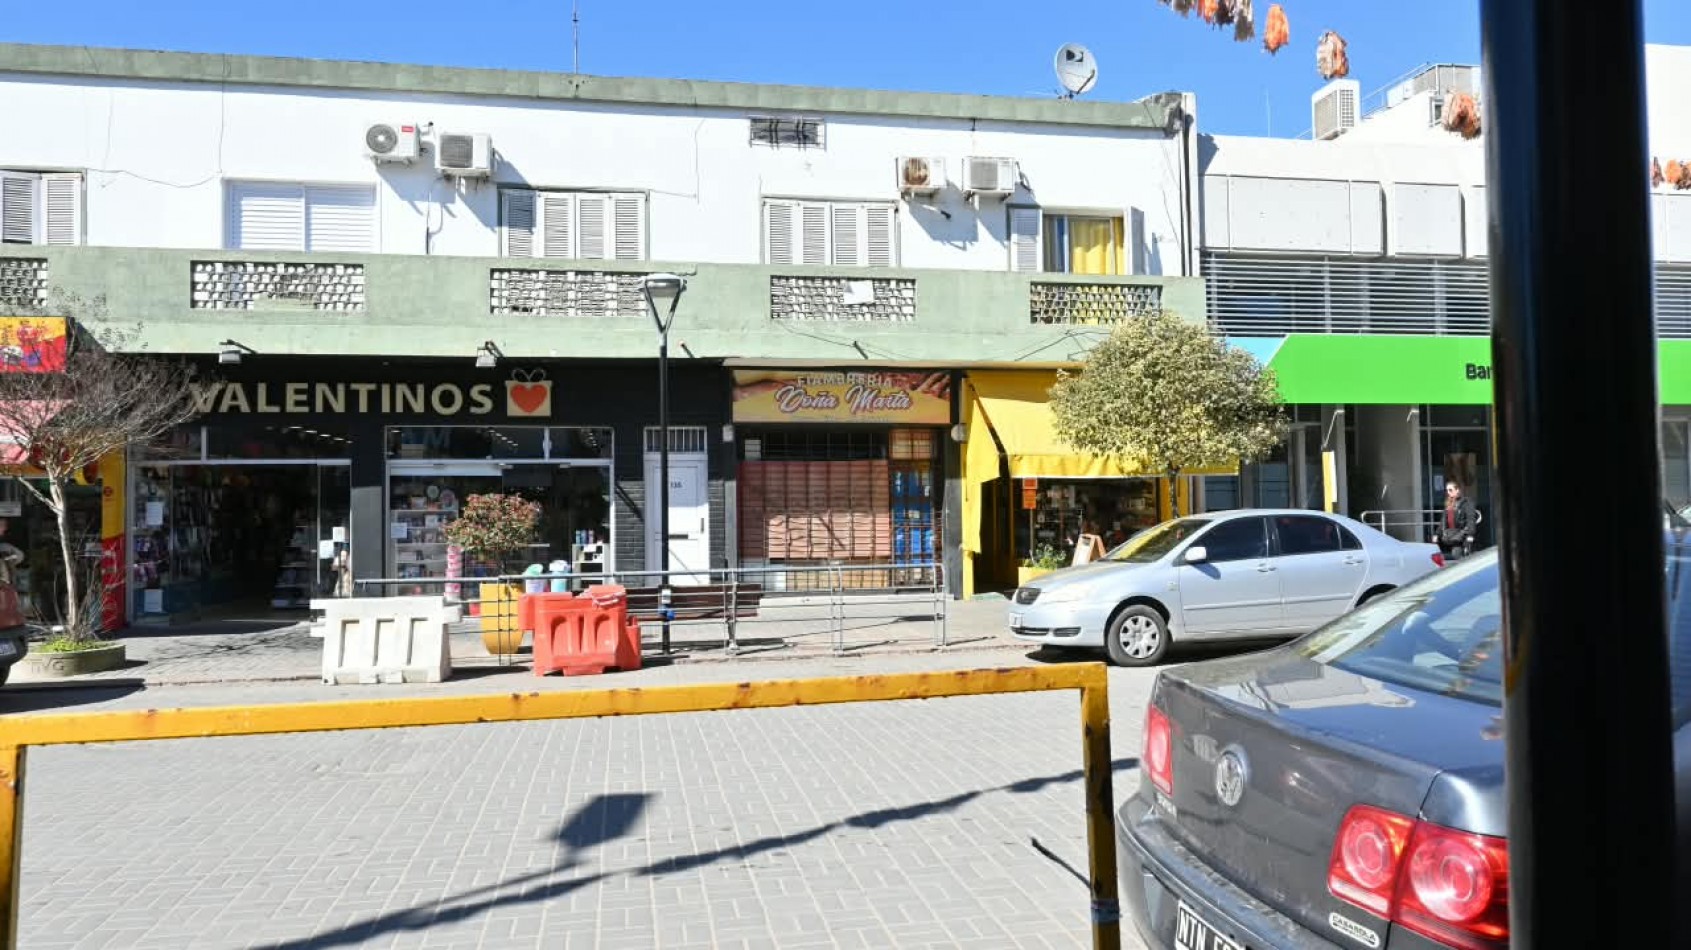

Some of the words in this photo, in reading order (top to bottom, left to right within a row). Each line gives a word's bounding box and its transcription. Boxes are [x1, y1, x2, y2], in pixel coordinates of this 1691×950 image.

[189, 382, 493, 415] VALENTINOS
[776, 385, 838, 412] Doña
[845, 385, 911, 414] Marta
[1179, 908, 1206, 950] NTN
